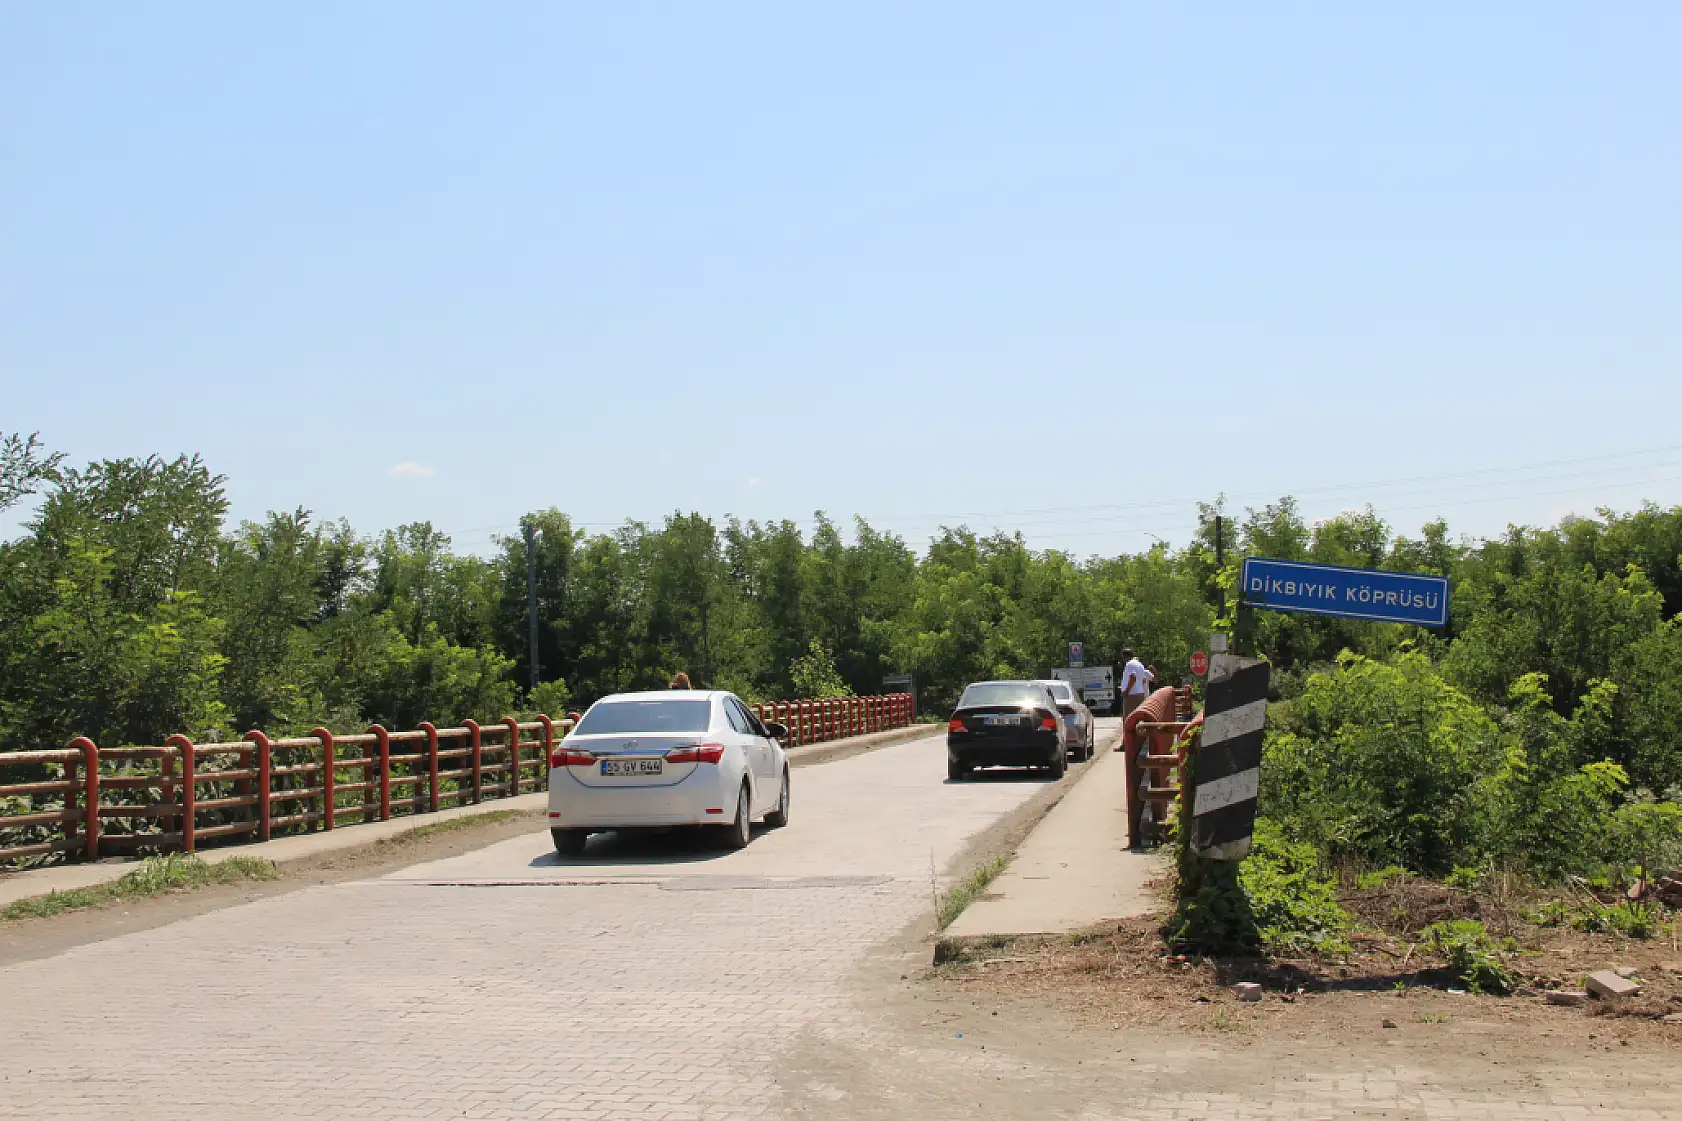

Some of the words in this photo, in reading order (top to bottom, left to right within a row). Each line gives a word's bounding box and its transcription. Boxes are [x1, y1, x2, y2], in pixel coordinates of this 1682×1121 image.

[1251, 575, 1337, 600] DİKBIYIK
[1346, 586, 1439, 609] KÖPRÜSÜ
[607, 762, 620, 772] 55
[623, 761, 637, 771] GV
[640, 760, 660, 771] 644
